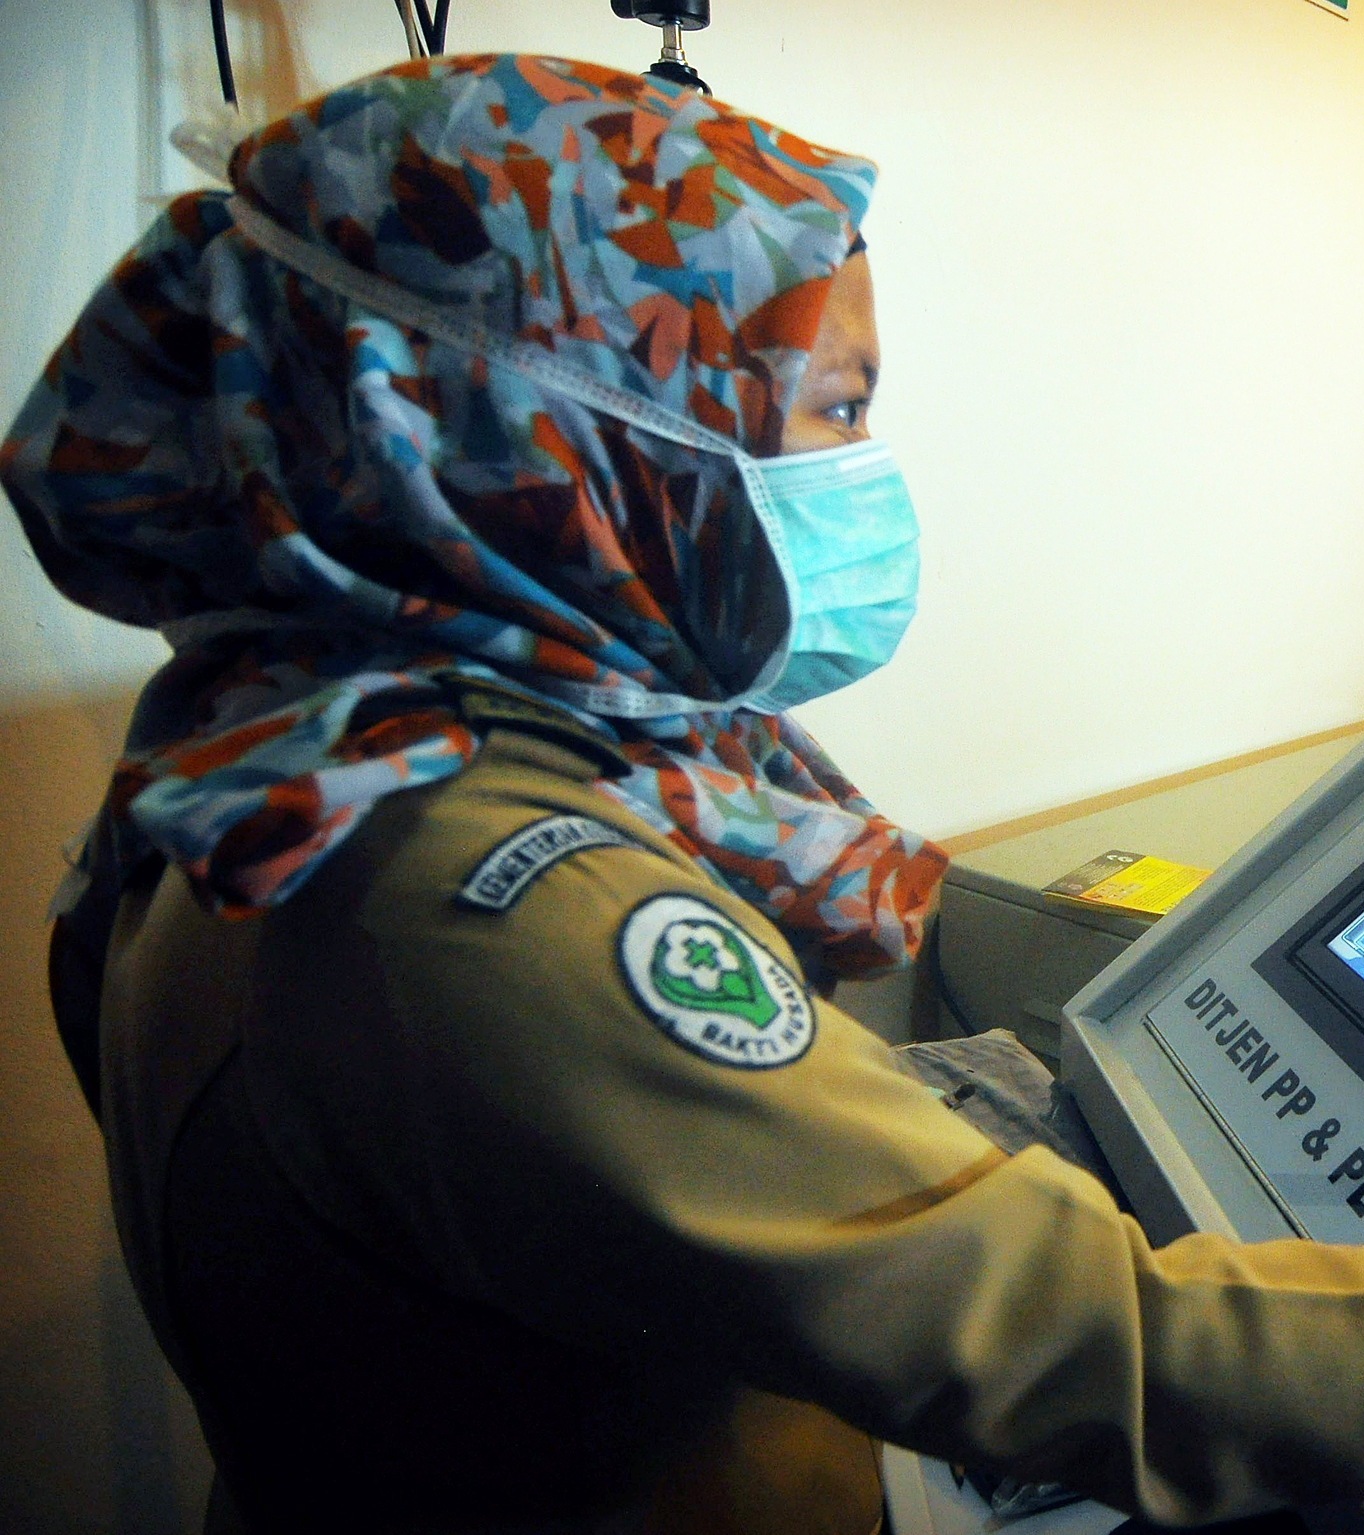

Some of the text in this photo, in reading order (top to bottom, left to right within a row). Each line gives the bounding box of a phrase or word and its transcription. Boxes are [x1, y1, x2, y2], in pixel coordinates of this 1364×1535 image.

[702, 965, 805, 1057] BAKTI HUSADA
[1184, 977, 1280, 1084] DITJEN
[1261, 1067, 1317, 1120] PP
[1302, 1118, 1341, 1162] &
